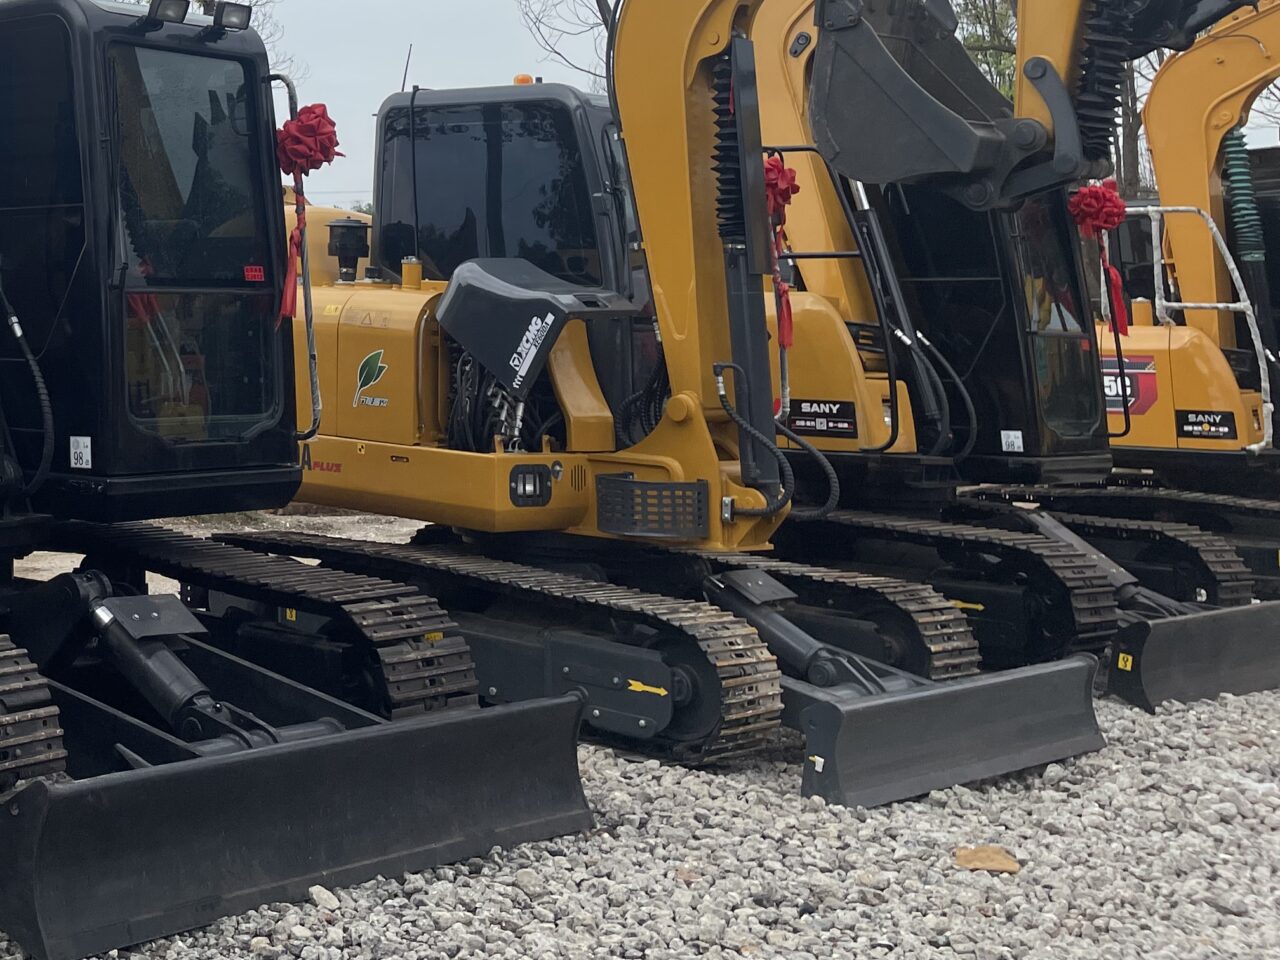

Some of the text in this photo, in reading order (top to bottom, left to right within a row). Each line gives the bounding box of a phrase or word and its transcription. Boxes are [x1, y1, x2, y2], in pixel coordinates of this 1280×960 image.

[517, 316, 542, 360] XCMG
[801, 403, 840, 414] SANY
[1188, 414, 1221, 423] SANY
[73, 451, 84, 466] 98
